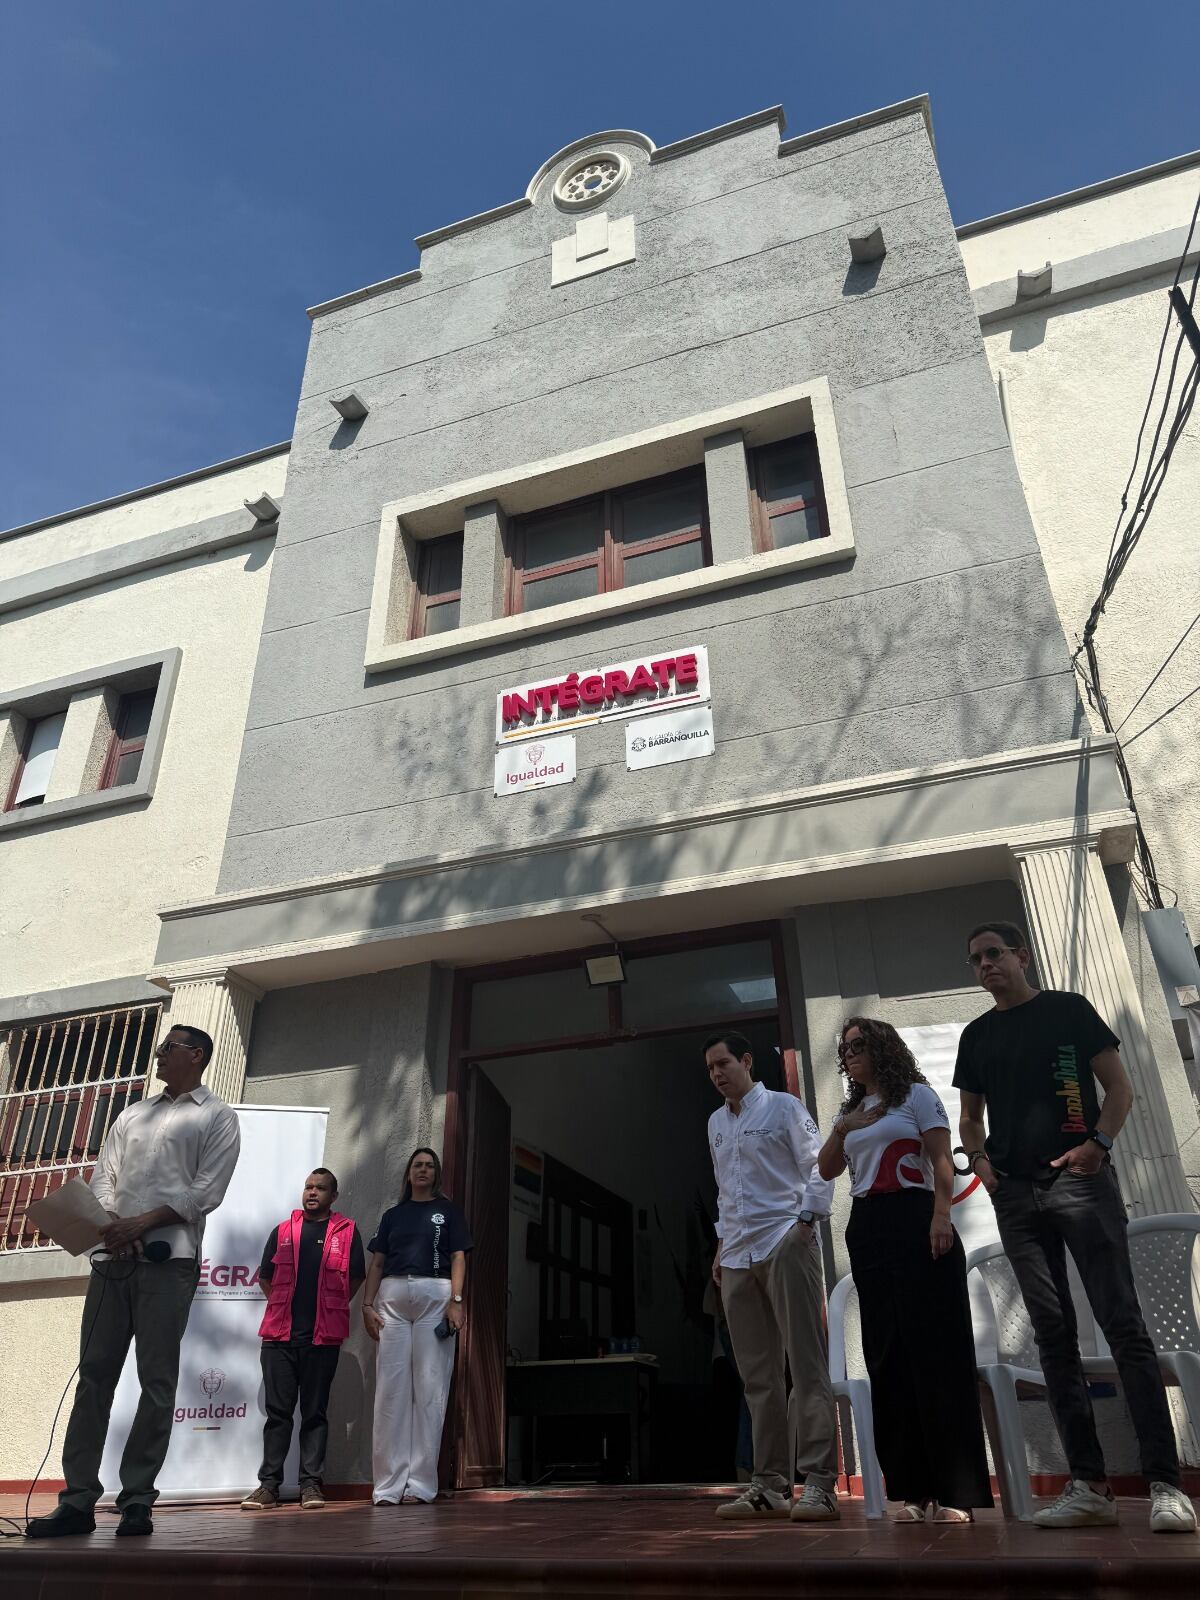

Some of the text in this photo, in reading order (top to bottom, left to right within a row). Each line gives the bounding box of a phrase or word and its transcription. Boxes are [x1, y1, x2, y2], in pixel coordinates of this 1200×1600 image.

[503, 653, 698, 723] INTÉGRATE
[648, 729, 710, 748] BARRANQUILLA
[506, 763, 564, 785] Igualdad
[174, 1402, 247, 1423] gualdad
